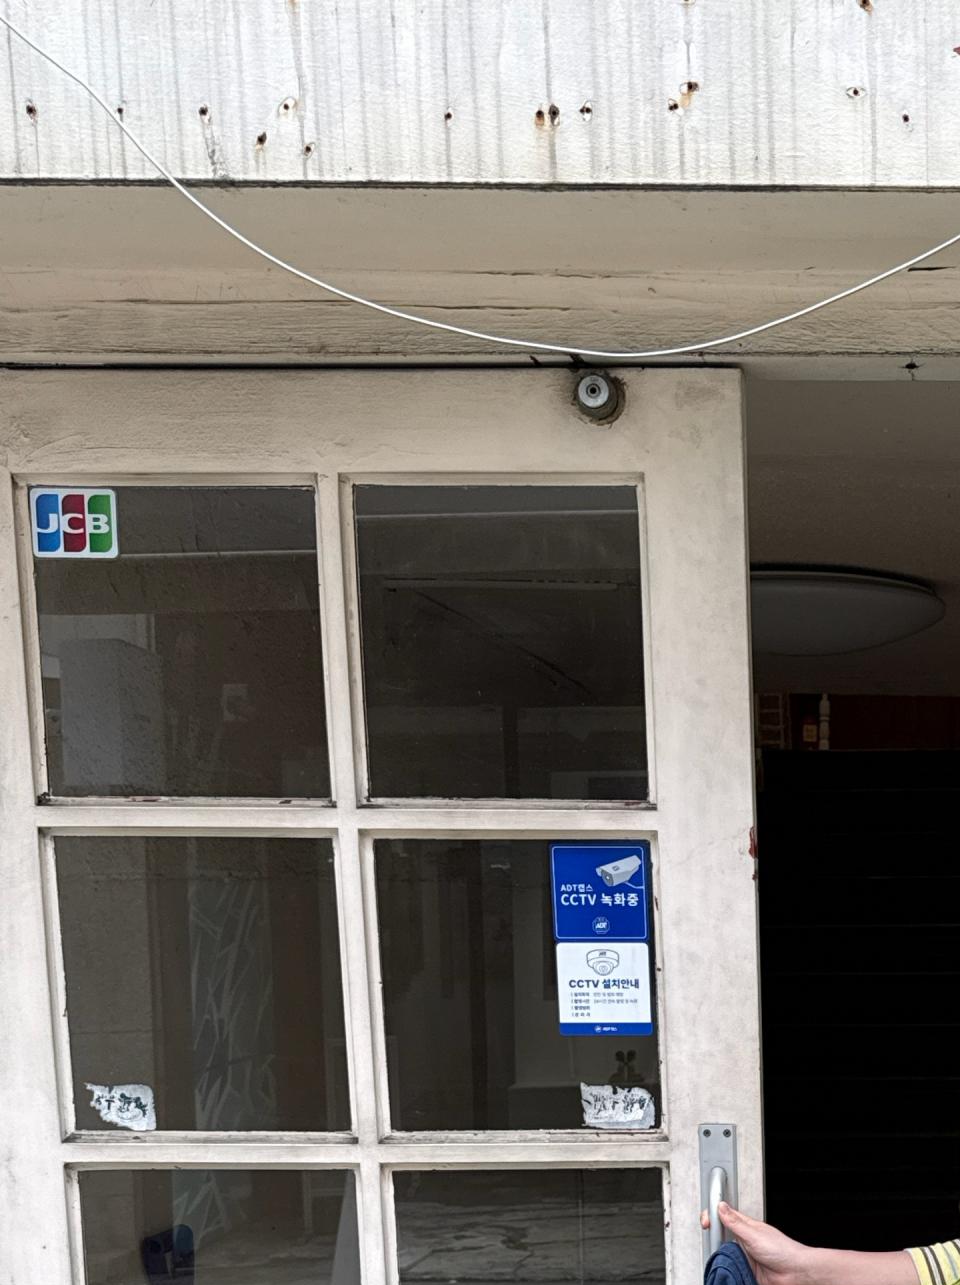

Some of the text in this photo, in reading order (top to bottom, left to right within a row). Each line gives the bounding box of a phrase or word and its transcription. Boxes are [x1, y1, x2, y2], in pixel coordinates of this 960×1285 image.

[36, 512, 110, 534] JCB
[560, 883, 593, 893] ADT캡스
[560, 892, 639, 907] CCTV 녹화중
[568, 978, 640, 990] CCTV 설치안내
